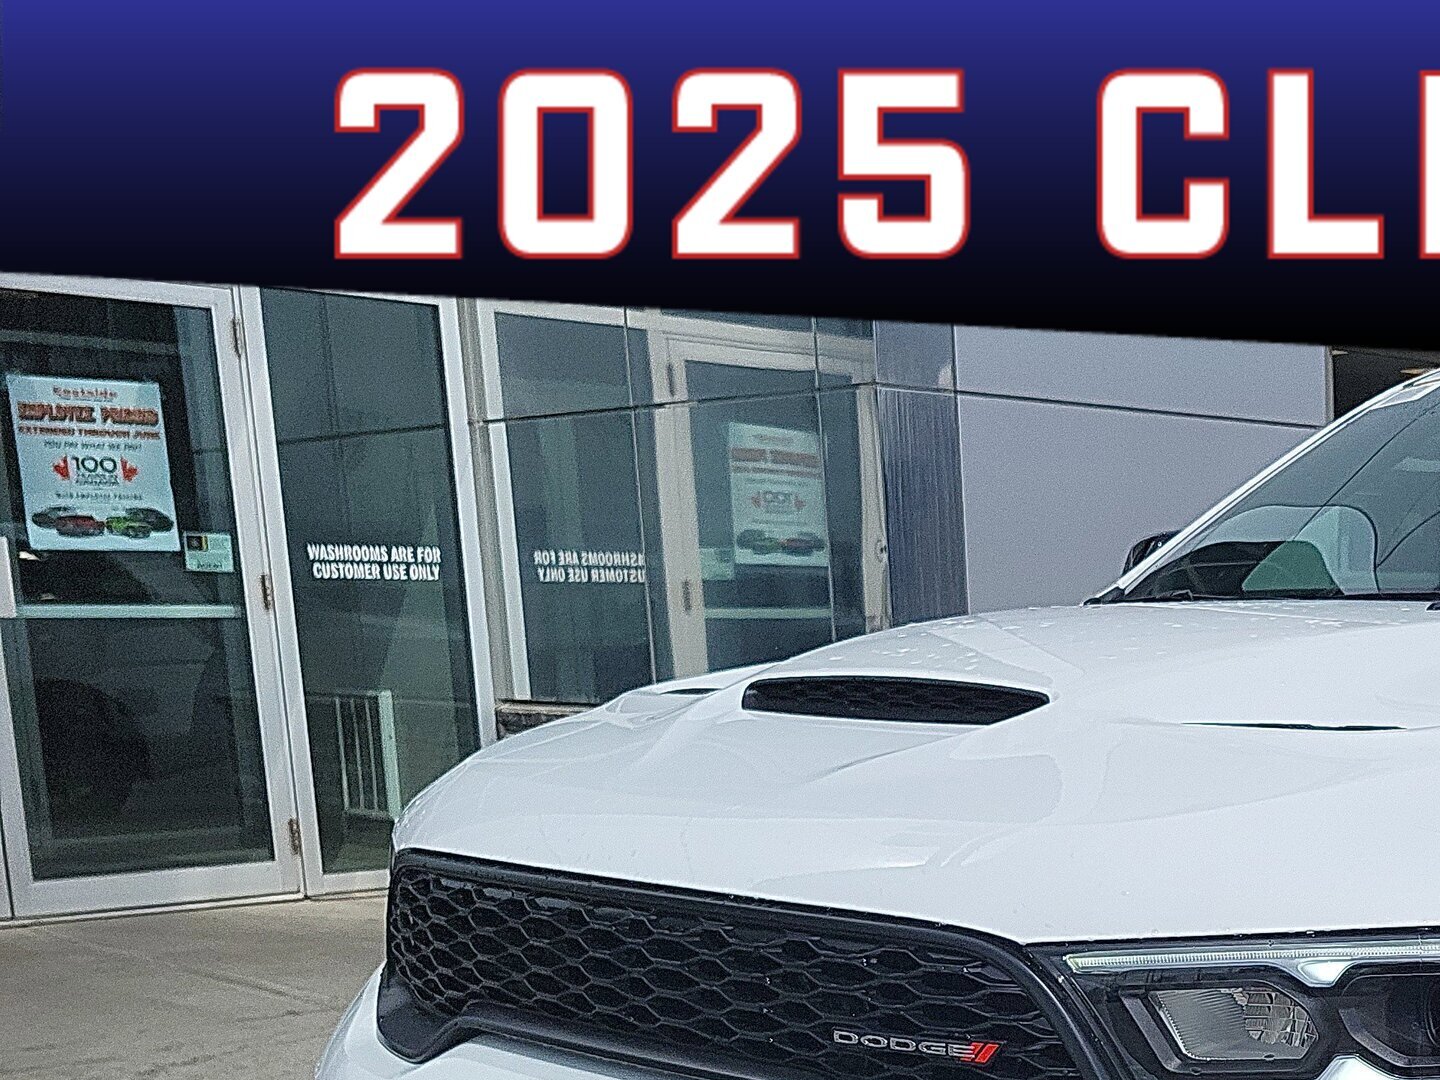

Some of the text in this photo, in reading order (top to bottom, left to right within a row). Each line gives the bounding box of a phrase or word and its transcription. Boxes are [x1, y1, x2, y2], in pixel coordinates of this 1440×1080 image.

[70, 456, 119, 474] 100
[307, 542, 442, 564] WASHROOMS ARE FOR
[312, 562, 440, 581] CUSTOMER USE ONLY
[833, 1030, 976, 1058] DODGE
